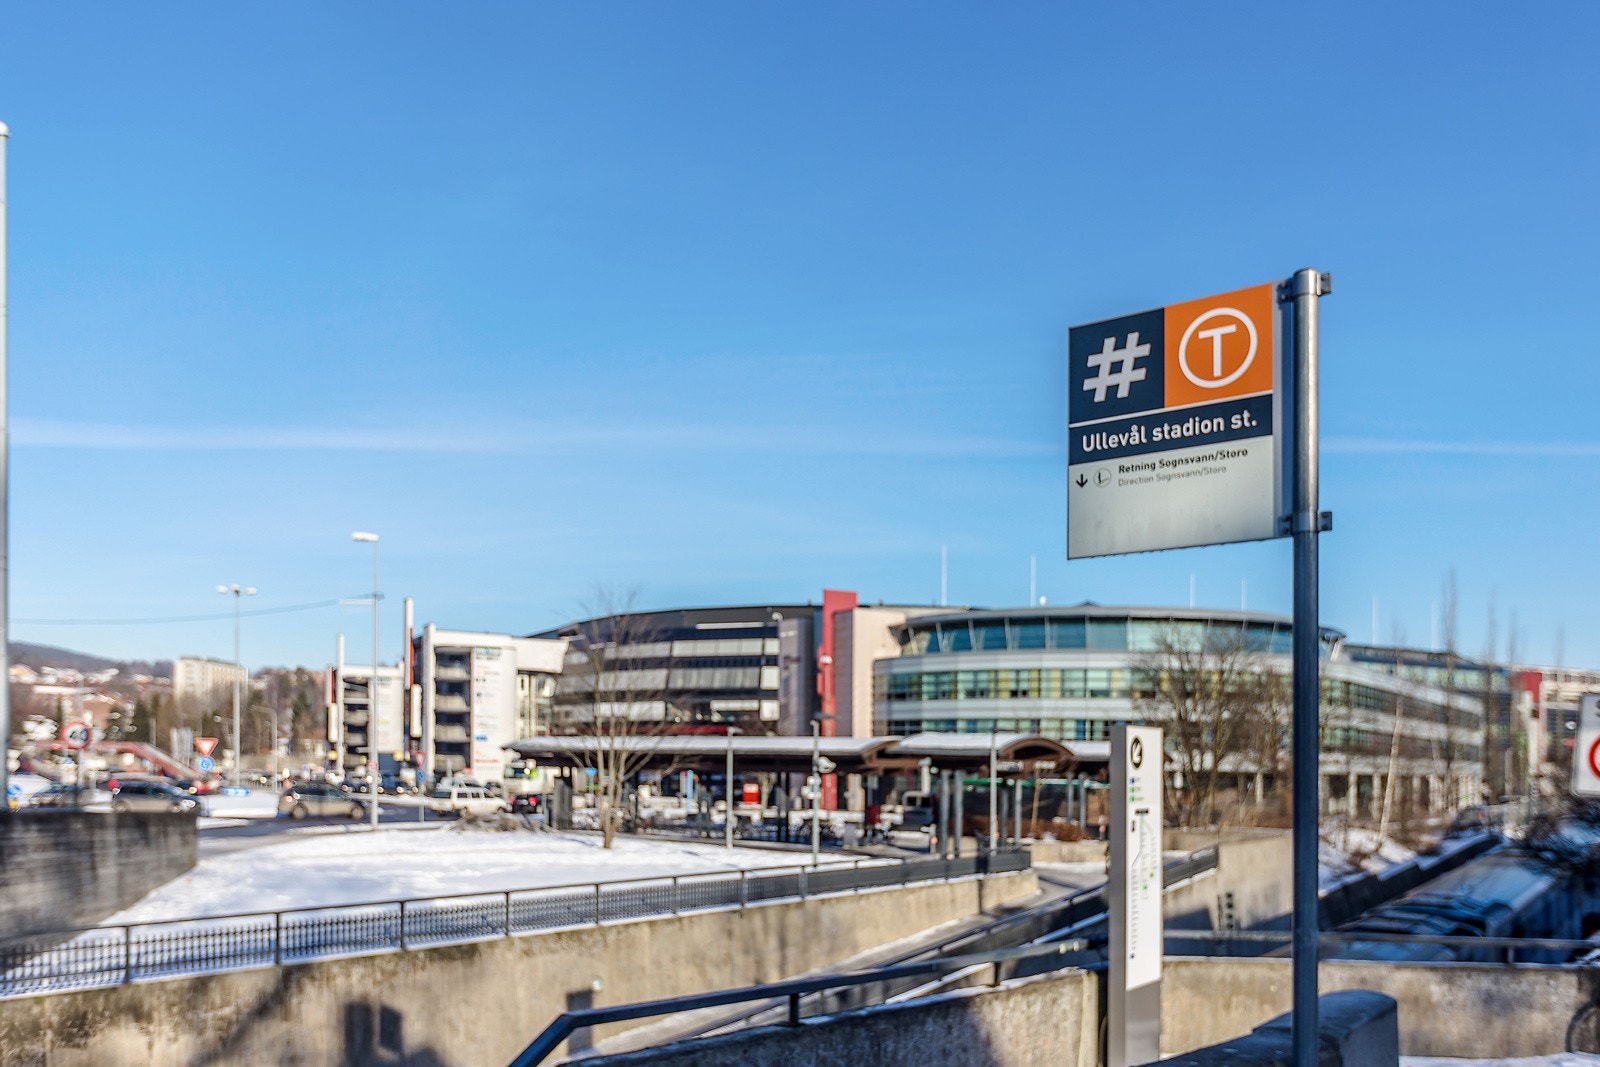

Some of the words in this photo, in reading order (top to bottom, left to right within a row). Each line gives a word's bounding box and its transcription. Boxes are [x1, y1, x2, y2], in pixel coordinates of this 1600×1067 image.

[1198, 324, 1237, 378] T
[1082, 424, 1147, 452] Ullevål
[1152, 416, 1225, 442] stadion
[1230, 409, 1258, 430] st.
[1118, 461, 1156, 474] Retning
[1158, 448, 1249, 469] Sognsvann/Storo
[1118, 475, 1154, 487] Direction
[1155, 465, 1227, 482] Sognsvann/Storo
